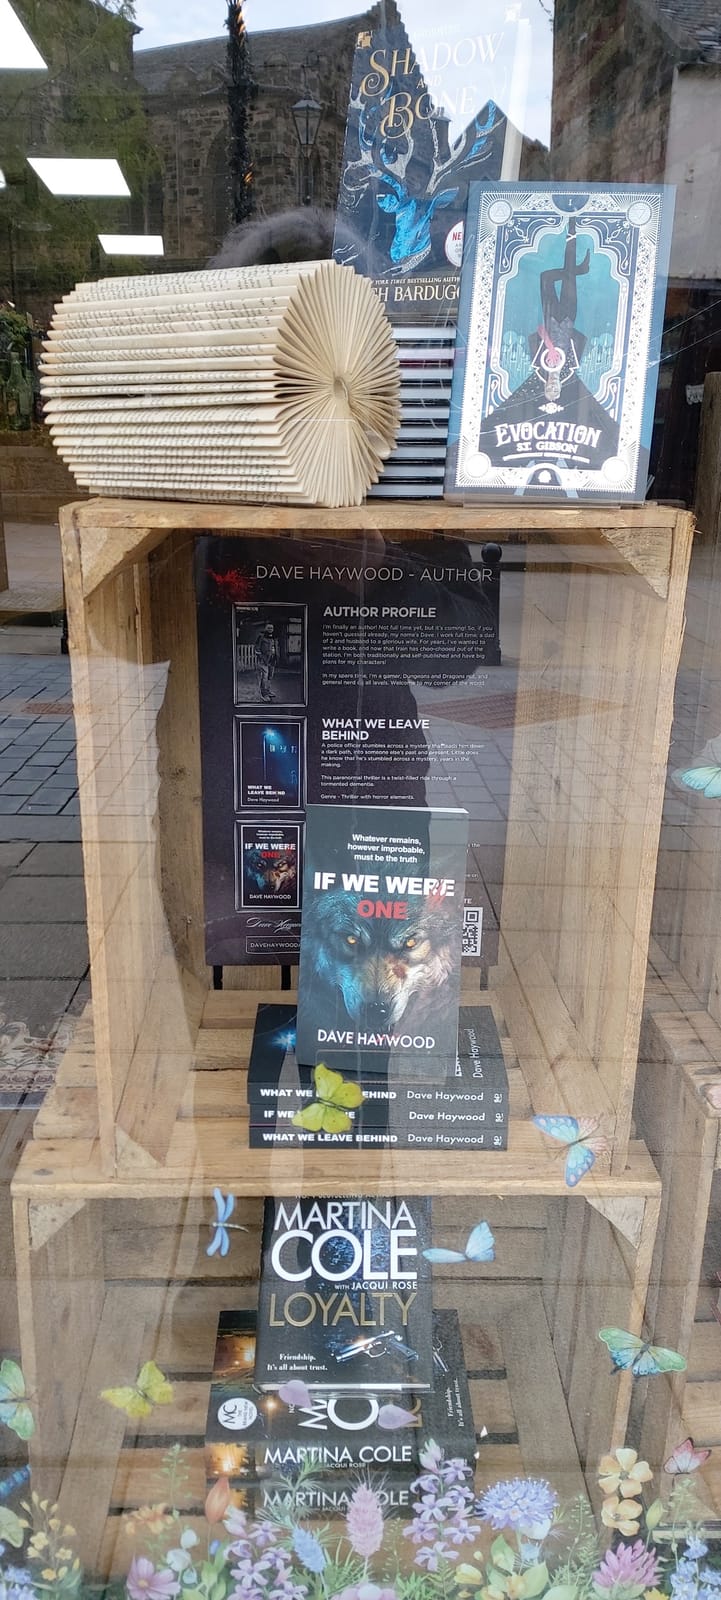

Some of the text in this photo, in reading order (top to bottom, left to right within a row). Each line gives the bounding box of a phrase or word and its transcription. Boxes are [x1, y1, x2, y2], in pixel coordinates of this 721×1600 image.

[360, 31, 504, 97] SHADOW
[416, 75, 442, 89] AND
[380, 86, 477, 138] BONE
[494, 421, 602, 448] EVOCATION
[536, 441, 579, 454] GIBSON
[256, 565, 304, 579] DAVE
[310, 567, 403, 581] HAYWOOD
[420, 568, 493, 582] AUTHOR
[323, 606, 436, 618] AUTHOR PROFILE
[322, 718, 429, 729] WHAT WE LEAVE
[322, 730, 369, 740] BEHIND
[352, 834, 421, 845] Whatever remains,
[347, 843, 425, 855] however improbable,
[314, 872, 455, 897] IF WE WERE
[357, 899, 408, 920] ONE
[317, 1029, 435, 1049] DAVE HAYWOOD
[464, 1028, 484, 1078] Dave Haywood
[260, 1089, 293, 1097] WHAT
[295, 1089, 313, 1097] WE
[362, 1091, 397, 1099] EHIND
[407, 1091, 432, 1100] Dave
[435, 1092, 484, 1102] Haywood
[409, 1111, 434, 1120] Dave
[437, 1112, 485, 1122] Haywood
[262, 1133, 295, 1141] WHAT
[356, 1134, 398, 1142] BEHIND
[408, 1134, 433, 1143] Dave
[436, 1134, 484, 1145] Haywood
[274, 1201, 416, 1230] MARTINA
[272, 1229, 417, 1281] COLE
[351, 1281, 388, 1290] JACQUI
[392, 1281, 417, 1289] ROSE
[269, 1292, 417, 1327] LOYALTY
[280, 1353, 316, 1362] Friendship.
[223, 1405, 237, 1424] MC
[264, 1446, 412, 1464] MARTINA COLE
[263, 1489, 409, 1507] MARTINA OLE
